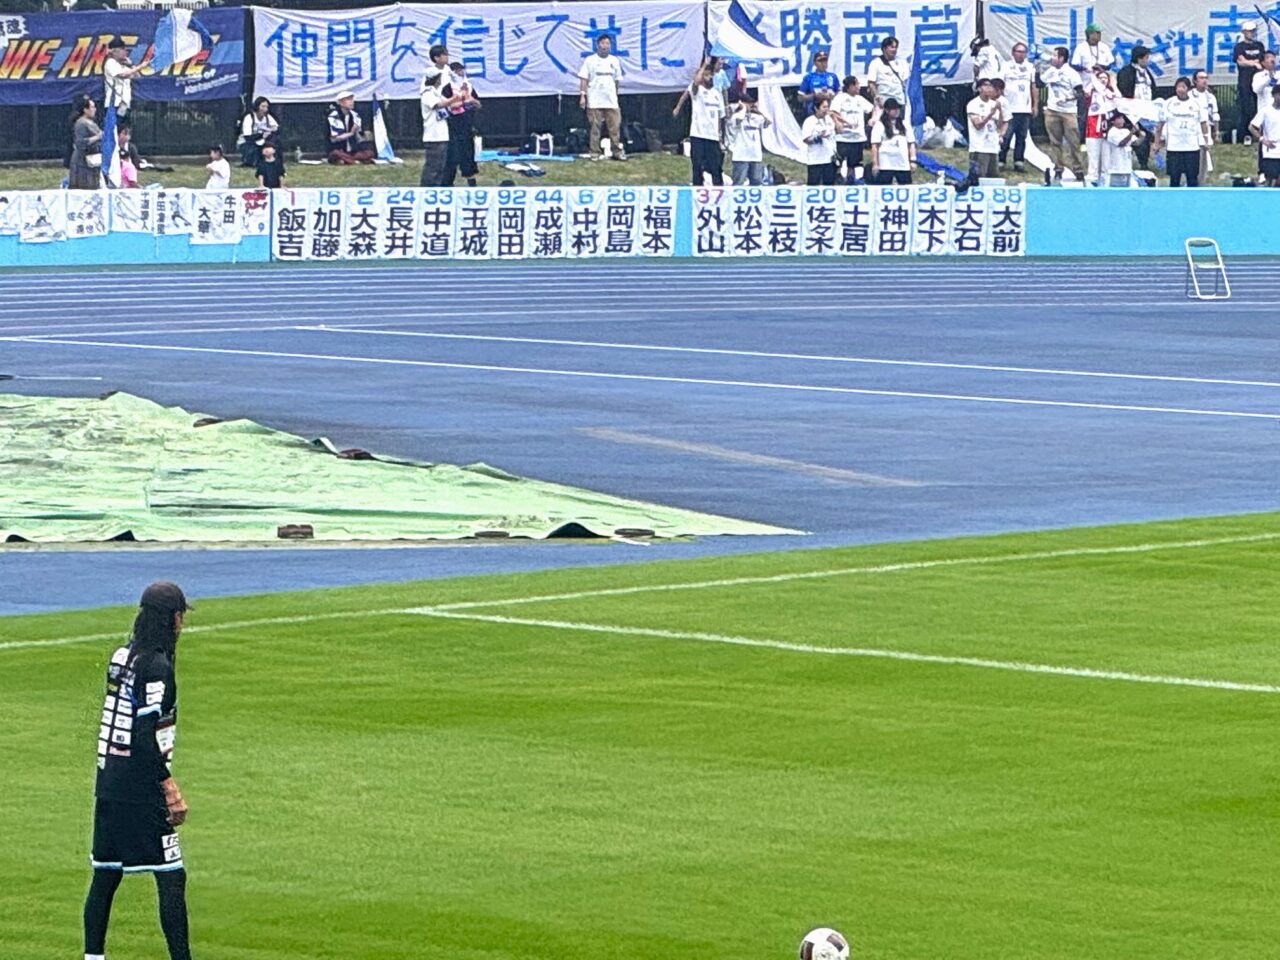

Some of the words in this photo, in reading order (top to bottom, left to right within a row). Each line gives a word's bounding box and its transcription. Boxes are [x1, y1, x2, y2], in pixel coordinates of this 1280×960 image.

[0, 38, 62, 80] WE
[57, 35, 139, 80] AR
[264, 14, 687, 87] 仲間を信じて共に
[319, 190, 341, 205] 16
[357, 190, 374, 205] 2
[386, 190, 416, 205] 24
[424, 190, 453, 205] 33
[465, 190, 488, 205] 19
[498, 190, 527, 205] 92
[534, 190, 563, 204] 44
[579, 189, 594, 204] 6
[607, 188, 636, 203] 26
[648, 188, 671, 204] 13
[696, 188, 724, 205] 37
[733, 188, 762, 204] 39
[775, 188, 792, 203] 8
[806, 188, 836, 203] 20
[845, 188, 868, 203] 21
[881, 188, 909, 203] 60
[918, 187, 947, 203] 23
[993, 188, 1021, 203] 88
[277, 207, 306, 257] 飯吉
[312, 207, 342, 257] 加藤
[348, 208, 379, 257] 大森
[384, 207, 414, 256] 長井
[420, 207, 451, 256] 中道
[459, 207, 489, 256] 玉城
[497, 207, 525, 256] 岡田
[534, 206, 564, 256] 成瀬
[571, 208, 599, 255] 中村
[605, 205, 635, 253] 岡島
[642, 205, 672, 253] 福本
[697, 206, 725, 253] 外山
[733, 205, 762, 254] 松本
[768, 205, 798, 253] 三枝
[805, 206, 836, 253] 佐々木
[839, 205, 869, 253] 土居
[879, 205, 909, 253] 神田
[917, 205, 947, 252] 木下
[954, 204, 983, 252] 大石
[992, 206, 1021, 253] 大前
